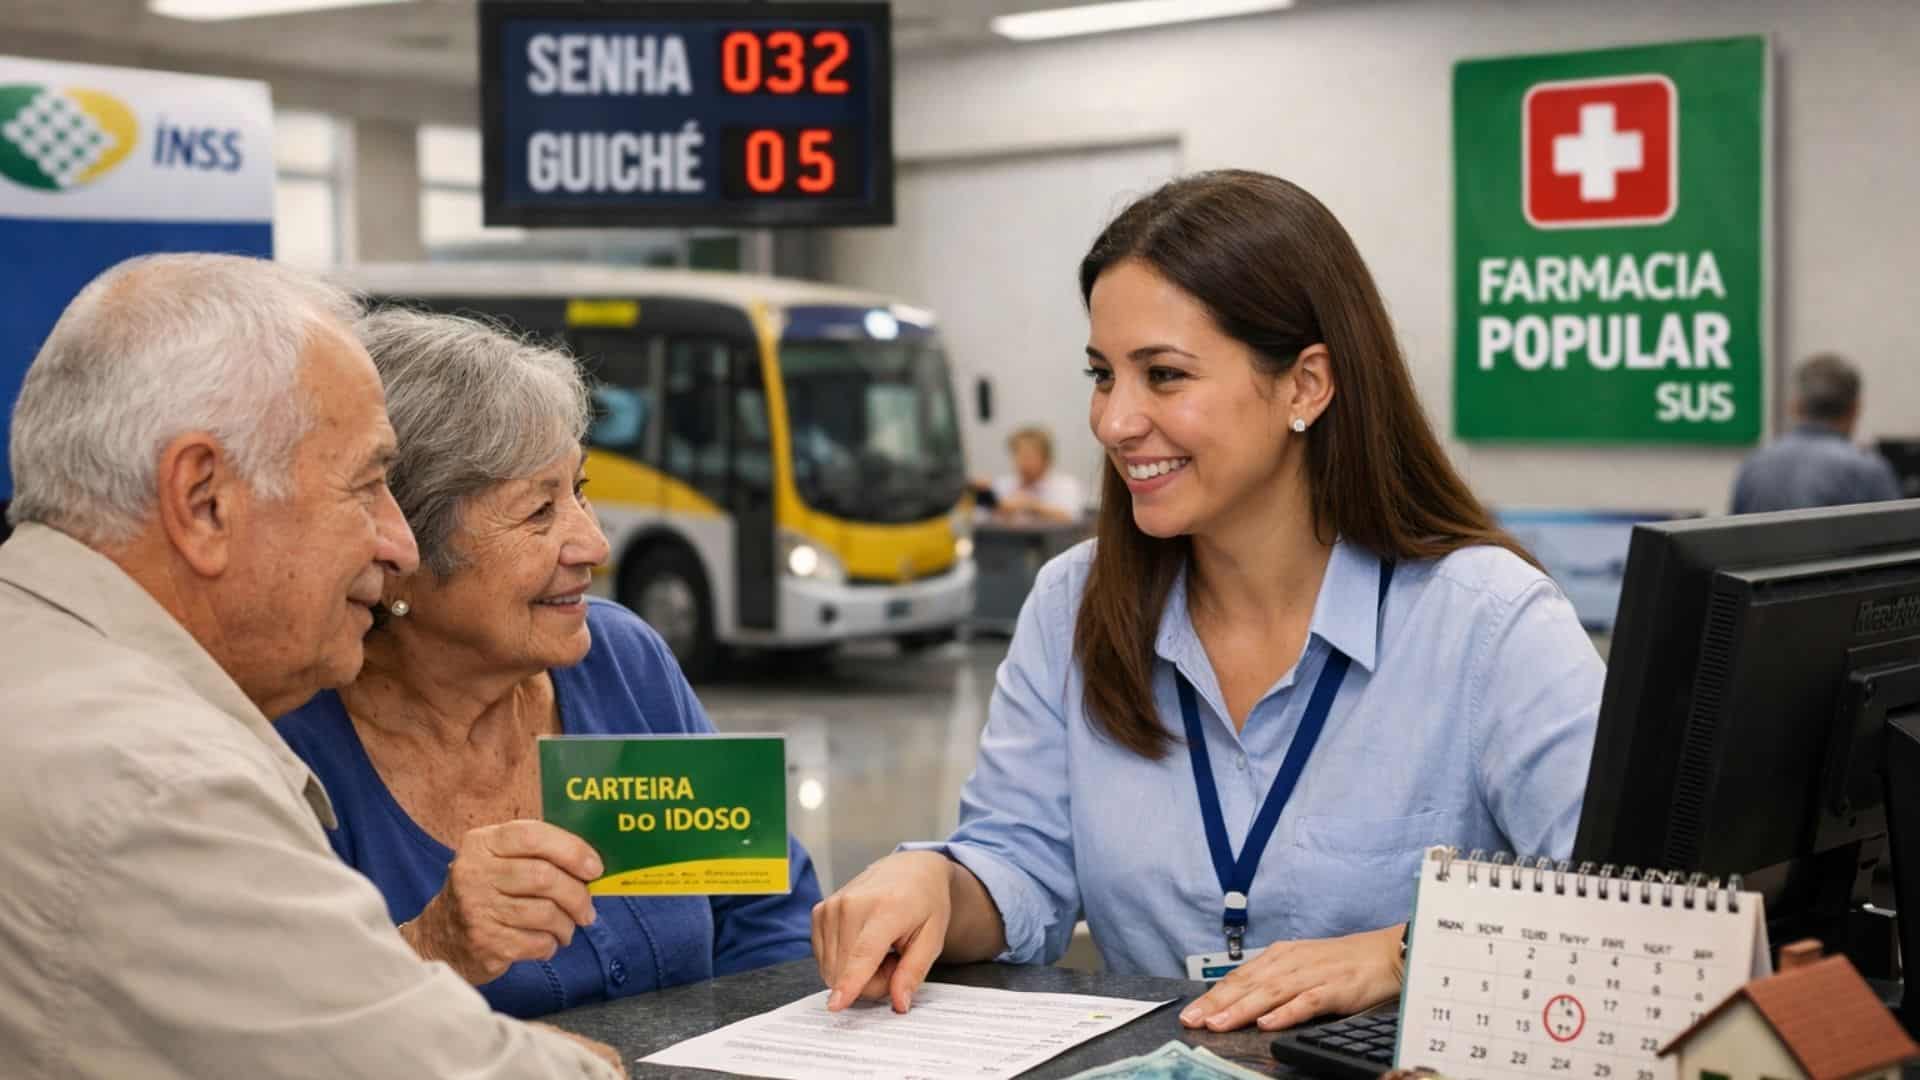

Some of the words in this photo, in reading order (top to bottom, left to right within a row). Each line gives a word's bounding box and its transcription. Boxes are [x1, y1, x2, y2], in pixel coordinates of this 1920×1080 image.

[527, 34, 692, 95] SENHA
[722, 30, 850, 94] 032
[527, 121, 704, 192] GUICHÉ
[1478, 250, 1726, 304] FARMACIA
[1478, 312, 1731, 370] POPULAR
[1656, 382, 1735, 421] SUS
[566, 776, 694, 801] CARTEIRA
[618, 813, 656, 832] DO
[665, 807, 751, 831] IDOSO
